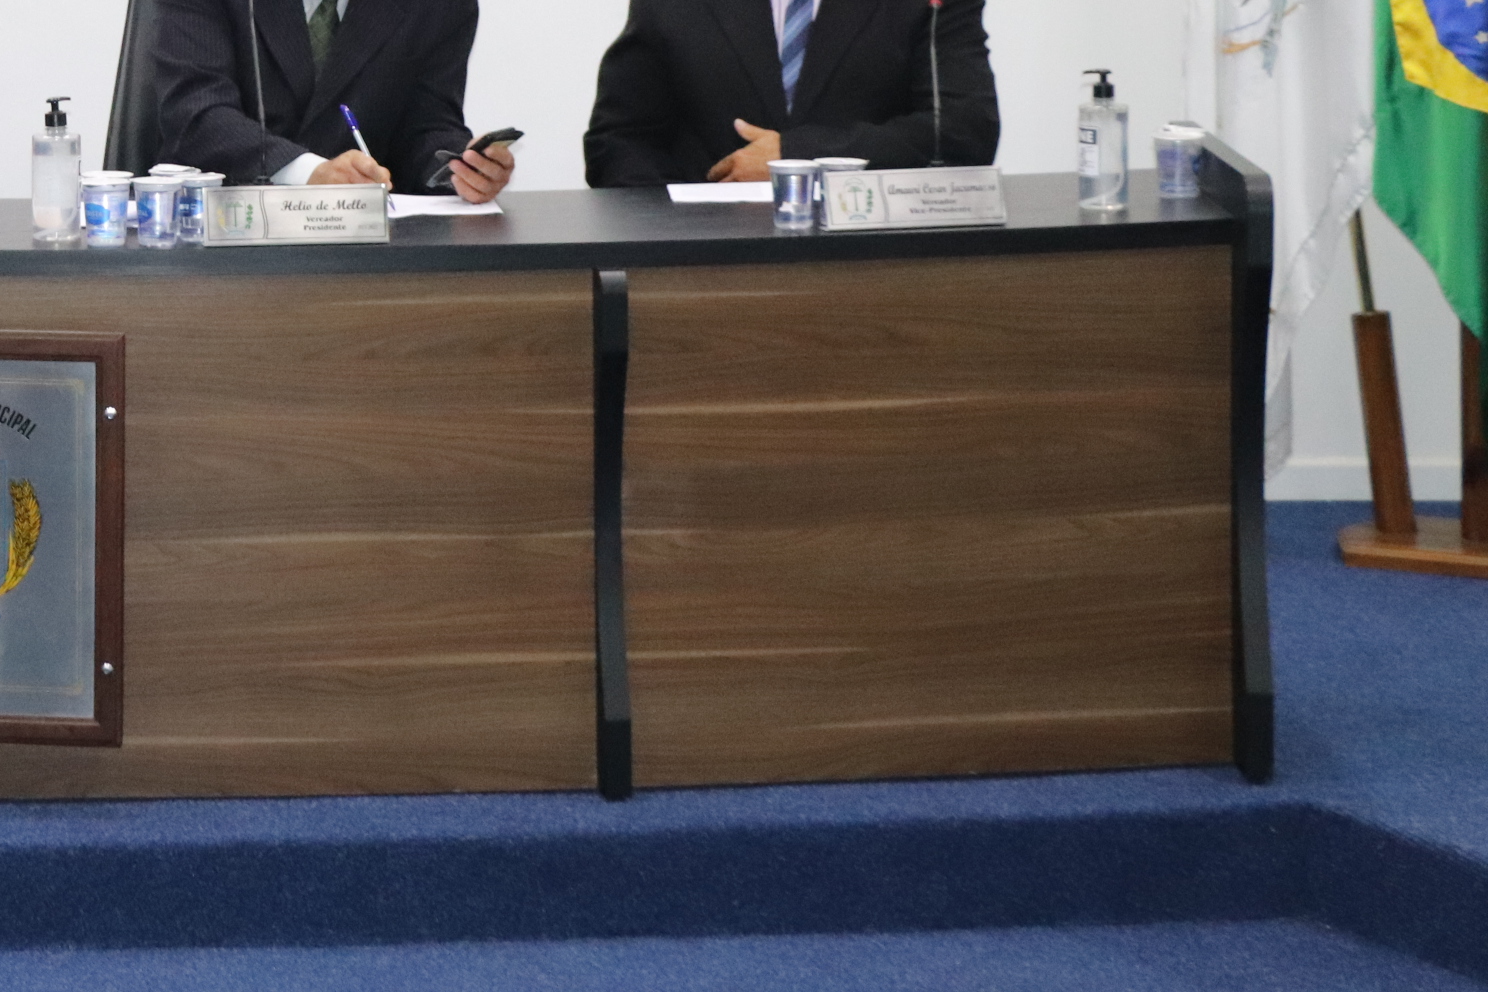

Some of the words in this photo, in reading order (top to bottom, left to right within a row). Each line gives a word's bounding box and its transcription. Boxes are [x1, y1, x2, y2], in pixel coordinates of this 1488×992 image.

[315, 199, 330, 211] de
[332, 198, 368, 211] Mello
[305, 215, 344, 223] Vereador
[303, 223, 347, 231] Presidente
